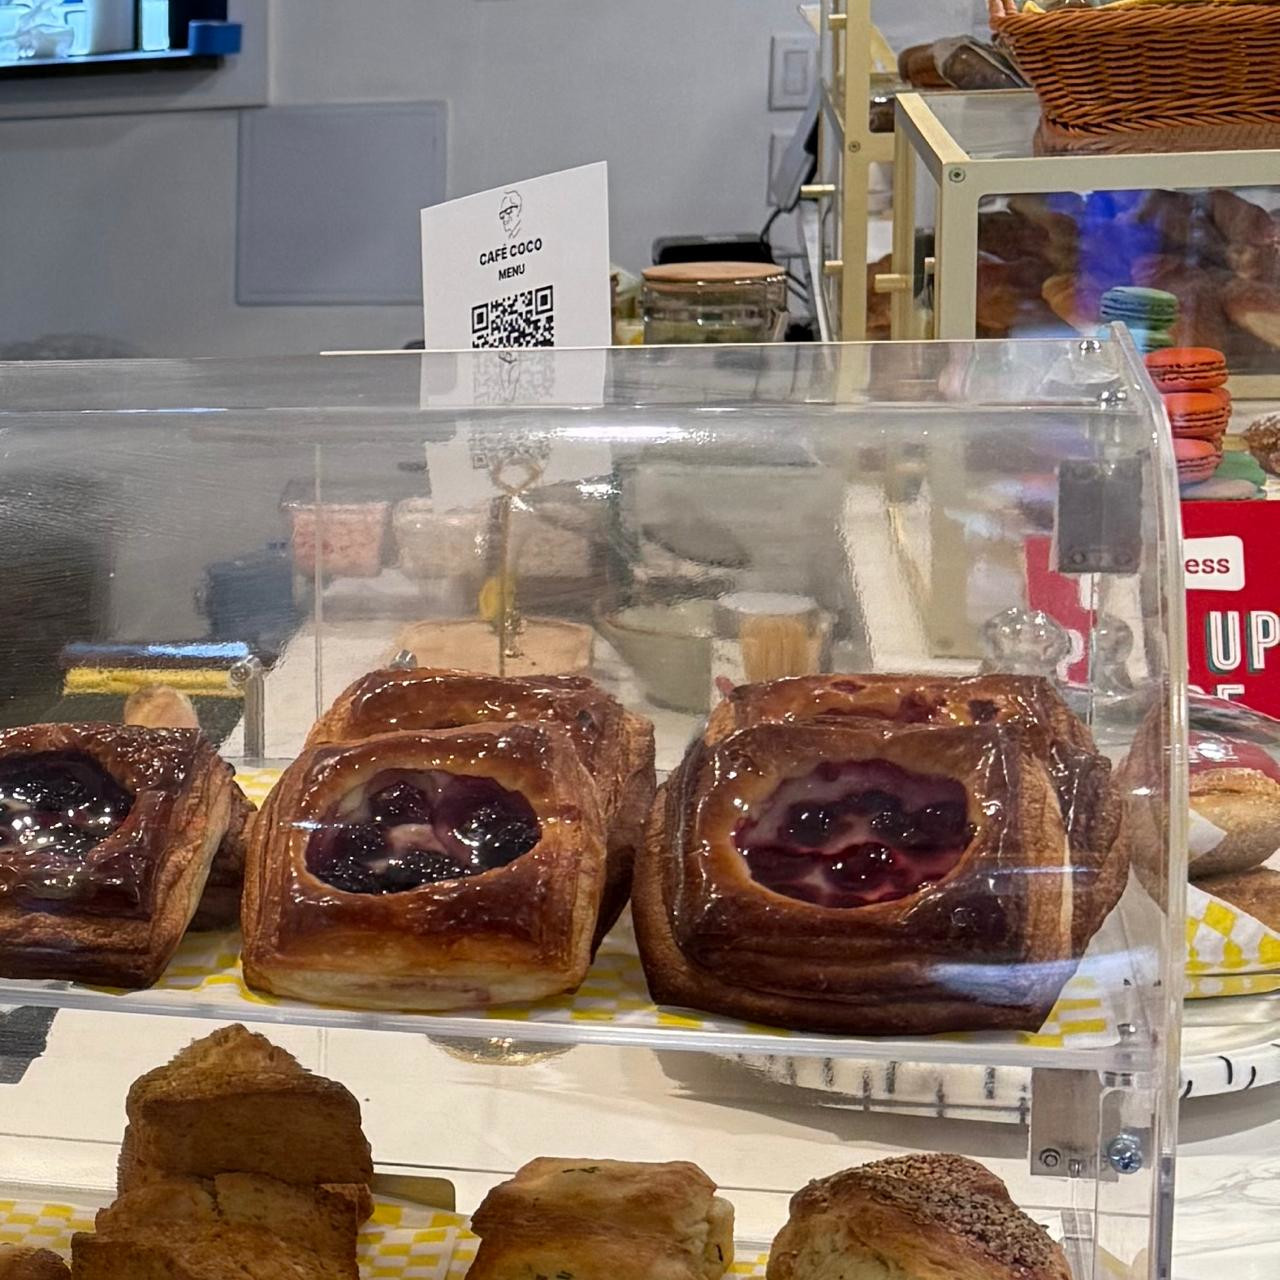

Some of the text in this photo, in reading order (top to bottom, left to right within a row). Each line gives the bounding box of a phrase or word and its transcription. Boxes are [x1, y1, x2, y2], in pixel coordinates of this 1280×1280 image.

[509, 238, 543, 257] COCO
[498, 263, 526, 281] MENU
[1208, 610, 1280, 672] UP
